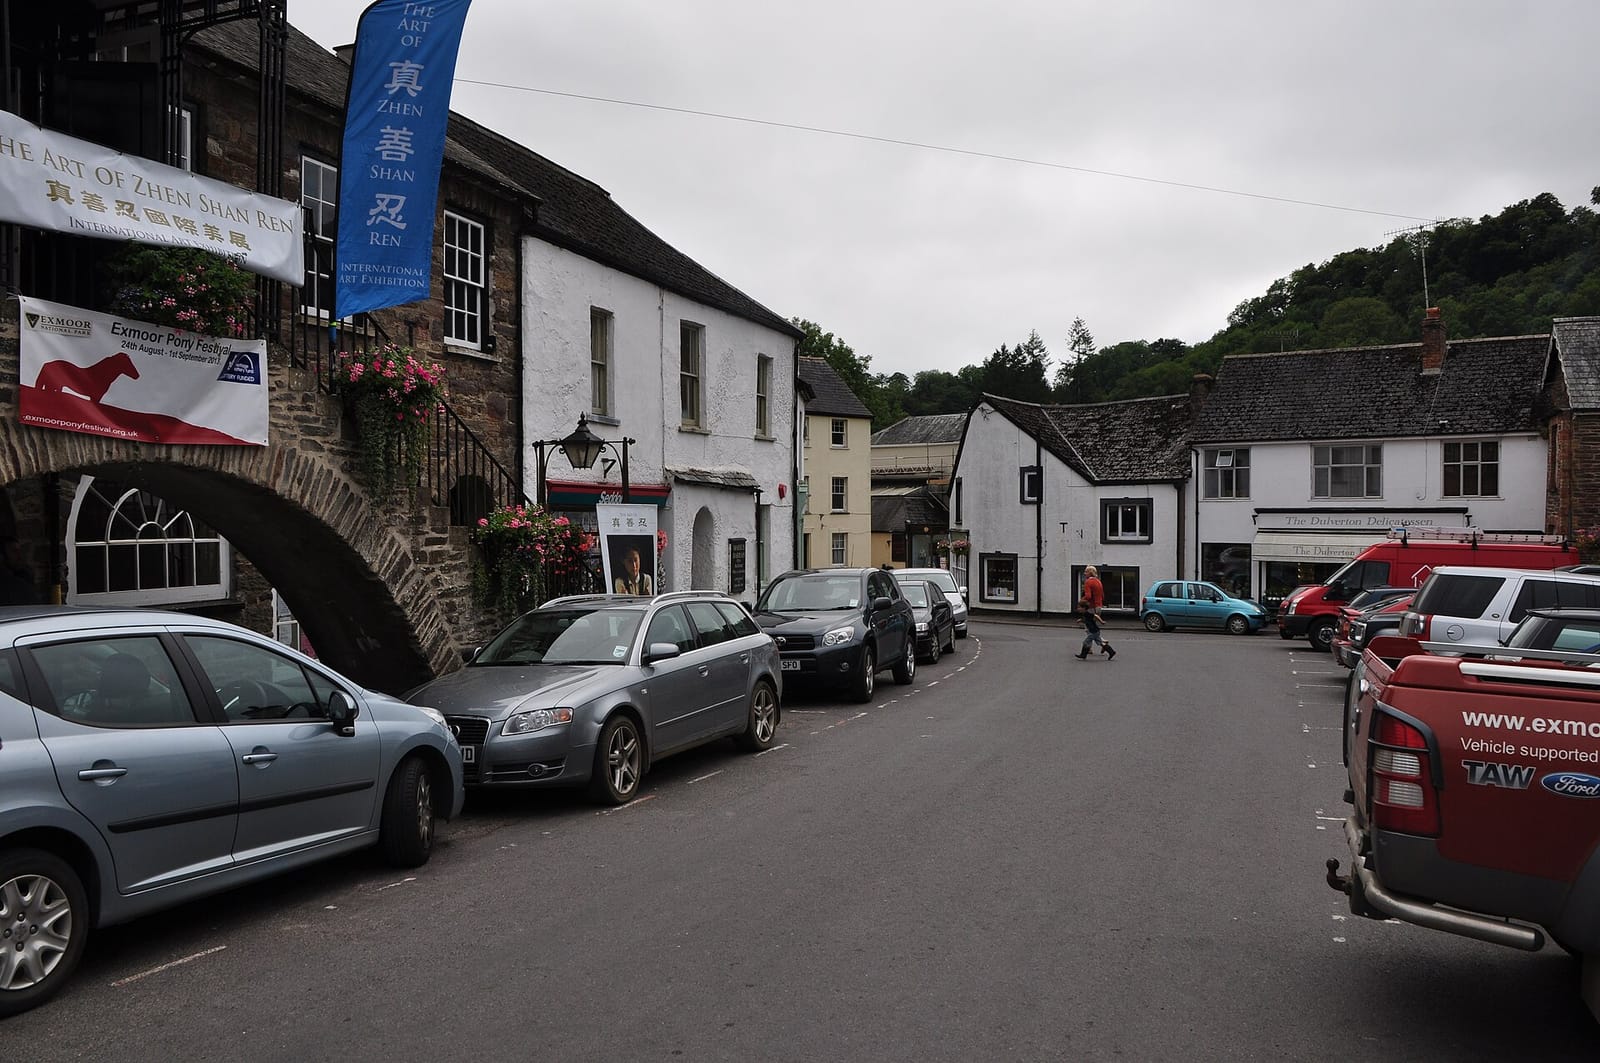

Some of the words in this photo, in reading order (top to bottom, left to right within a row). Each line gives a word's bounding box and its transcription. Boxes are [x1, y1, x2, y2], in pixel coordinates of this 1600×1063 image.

[404, 3, 435, 18] THE
[397, 17, 430, 33] ART
[401, 35, 423, 47] OF
[384, 60, 424, 97] 真
[375, 125, 414, 162] 善
[43, 147, 86, 179] ART
[95, 166, 125, 188] OF
[367, 194, 407, 230] 忍
[339, 275, 357, 284] ART
[341, 262, 424, 277] INTERNATIONAL
[41, 315, 91, 329] EXMOOR
[111, 322, 164, 344] Exmoor
[166, 332, 194, 352] Pony
[121, 340, 138, 350] 24th
[139, 344, 164, 356] August
[178, 351, 207, 364] September
[1285, 516, 1307, 526] The
[1310, 516, 1362, 526] Dulverton
[1293, 546, 1309, 556] The
[1311, 547, 1355, 556] Dulverton
[1460, 737, 1515, 755] Vehicle
[1520, 745, 1599, 763] supported
[1462, 760, 1536, 789] TAW
[1554, 775, 1600, 796] Ford
